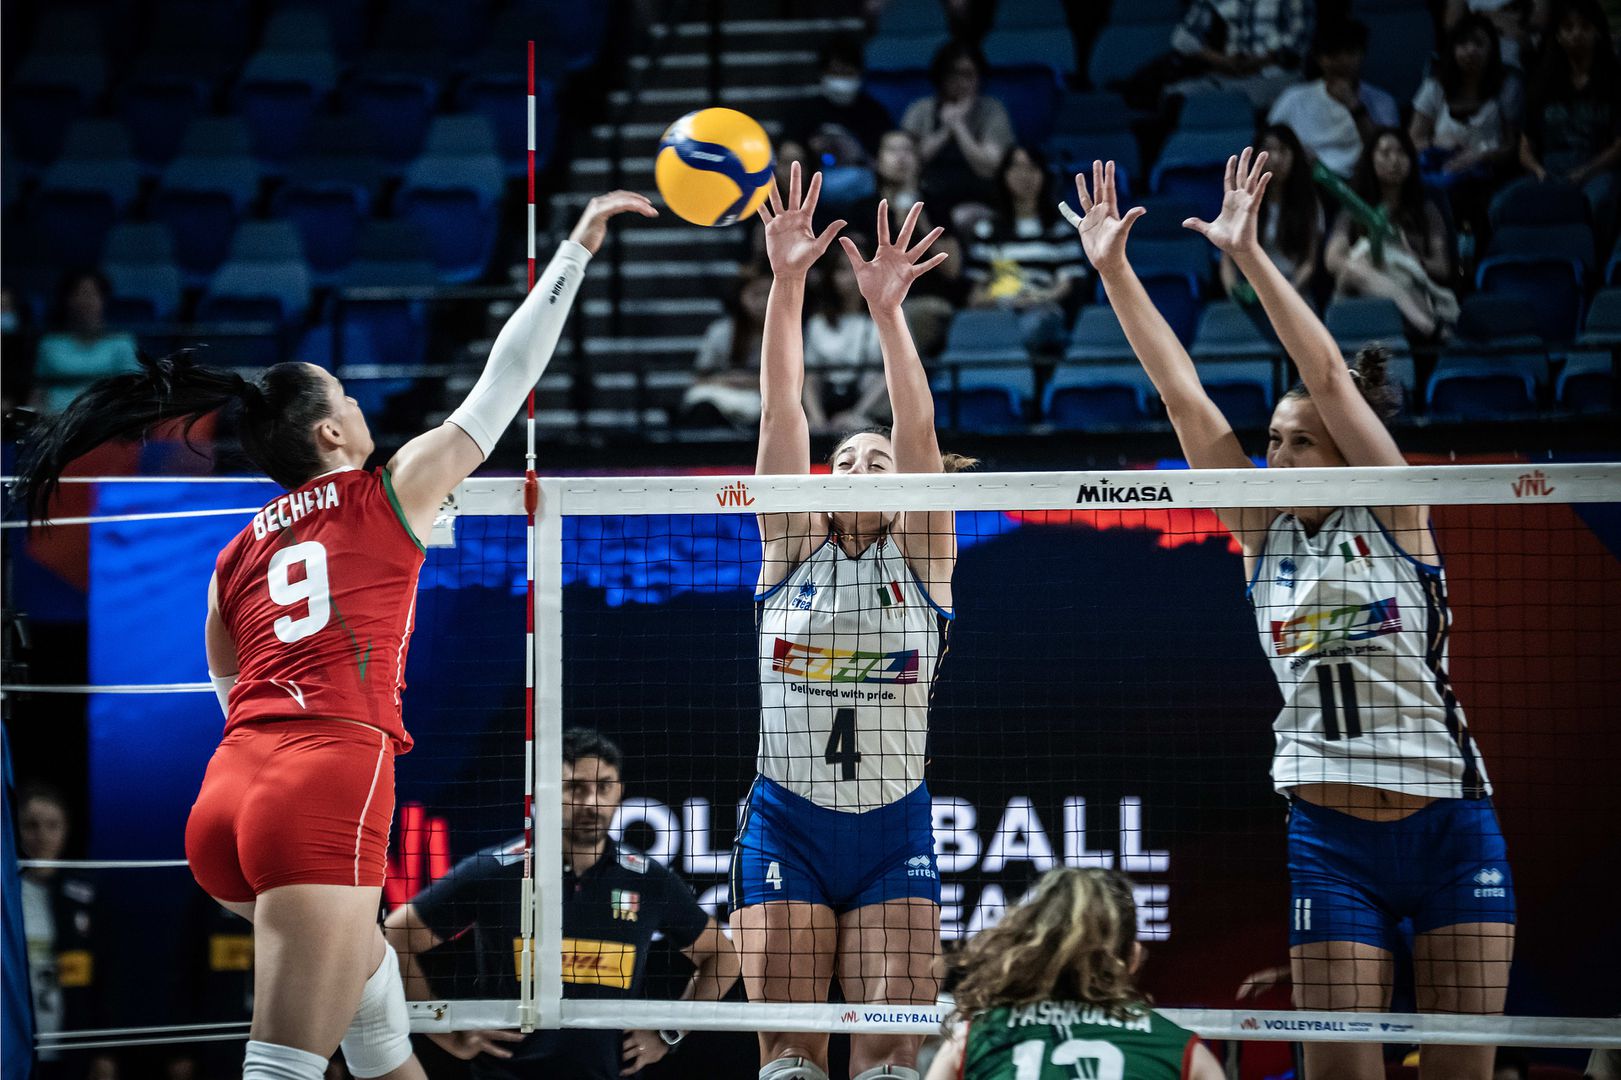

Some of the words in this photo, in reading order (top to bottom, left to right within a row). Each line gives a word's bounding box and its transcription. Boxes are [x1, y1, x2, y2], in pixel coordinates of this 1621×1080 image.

[716, 480, 755, 507] VNL
[1076, 480, 1173, 503] MIKASA
[252, 481, 340, 541] BECHEVA
[267, 540, 330, 643] 9
[790, 682, 838, 698] Delivered
[841, 689, 864, 699] with
[867, 690, 897, 701] pride.
[1316, 661, 1363, 741] 11
[825, 708, 861, 781] 4
[766, 861, 782, 890] 4
[1295, 898, 1312, 930] 11
[864, 1012, 942, 1024] VOLLEYBALL
[1264, 1019, 1346, 1032] VOLLEYBALL
